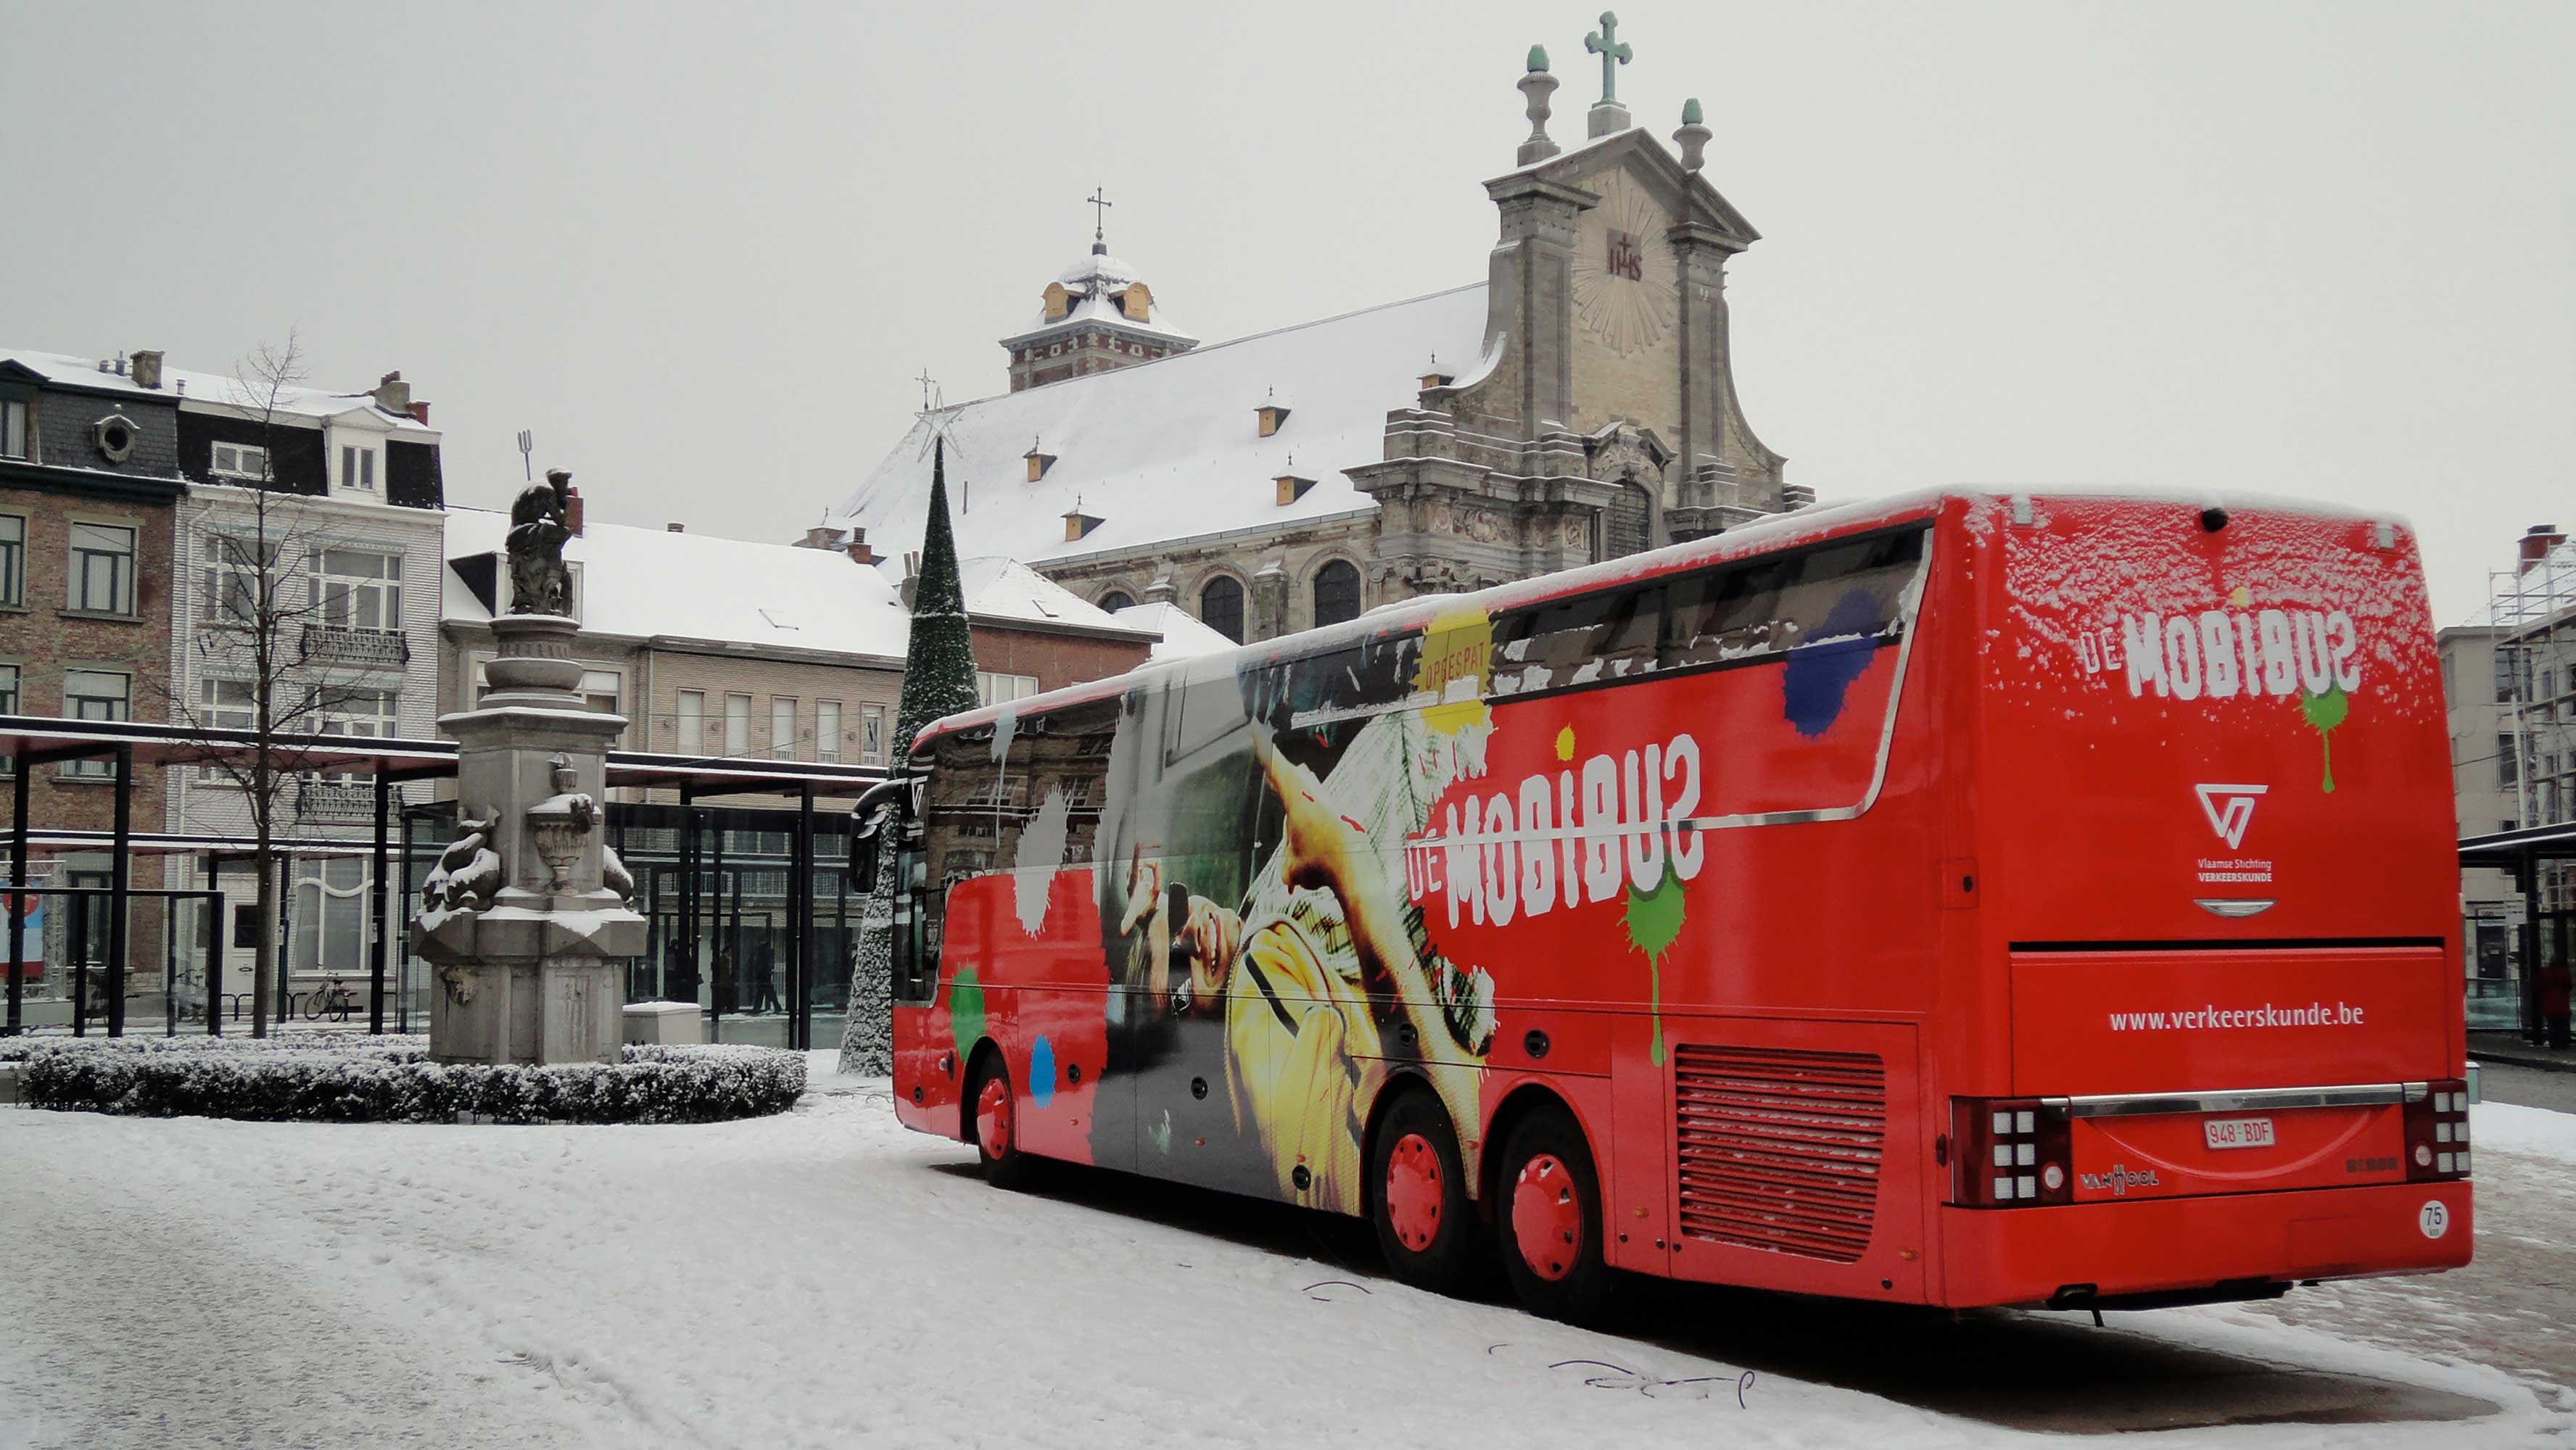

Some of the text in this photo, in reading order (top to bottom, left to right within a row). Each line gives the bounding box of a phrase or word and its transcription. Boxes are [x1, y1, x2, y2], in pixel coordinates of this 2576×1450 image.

[2079, 609, 2361, 700] DE MOBIBUS
[1407, 733, 1704, 929] DE MOBIBUS
[2197, 858, 2272, 872] Vlaamse Stichting
[2198, 872, 2273, 882] VERKEERSKUNDE
[2110, 1002, 2364, 1030] www.verkeerskunde.be
[2424, 1206, 2443, 1226] 75
